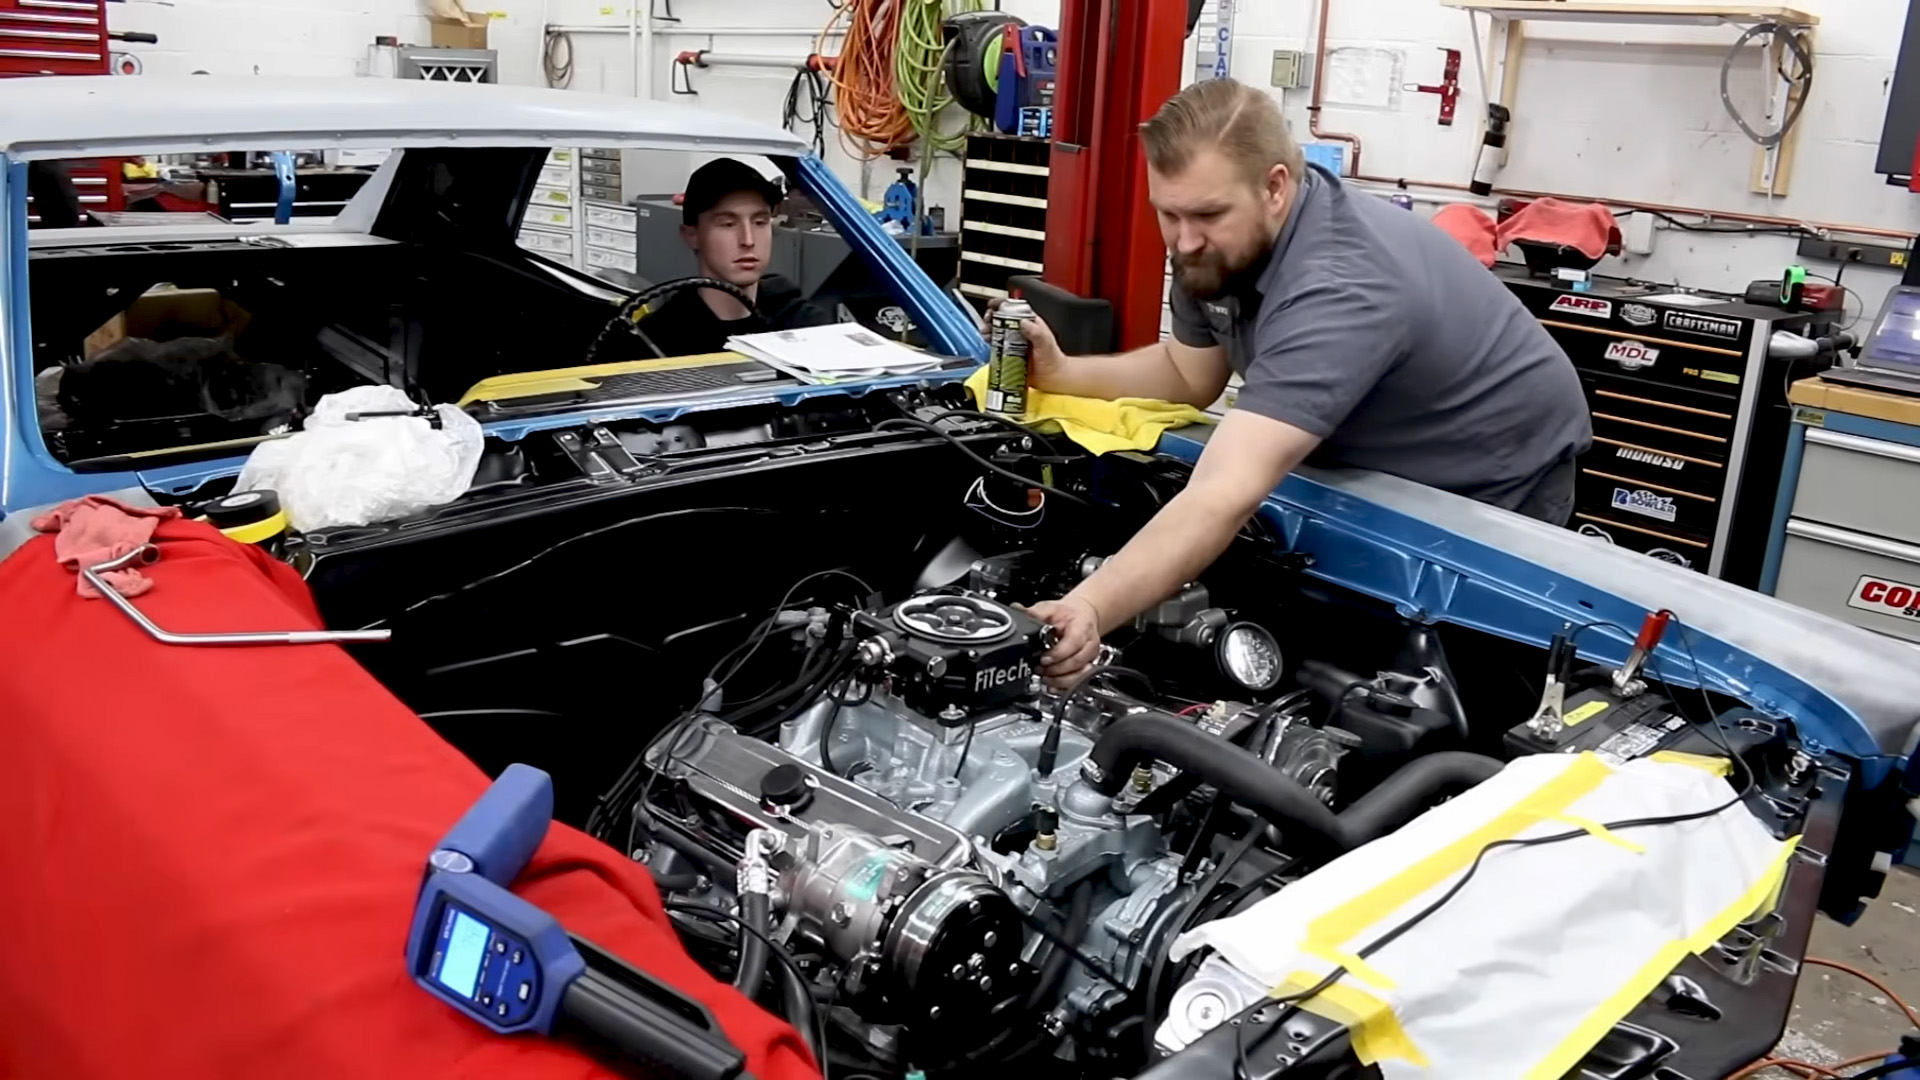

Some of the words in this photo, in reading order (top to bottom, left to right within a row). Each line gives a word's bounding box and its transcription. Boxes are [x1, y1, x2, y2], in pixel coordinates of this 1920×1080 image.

[1556, 296, 1608, 310] ARP
[1669, 316, 1736, 335] CRAFTSMAN
[1609, 344, 1653, 362] MDL
[1630, 496, 1675, 513] BOWLER
[974, 658, 1029, 692] FiTech
